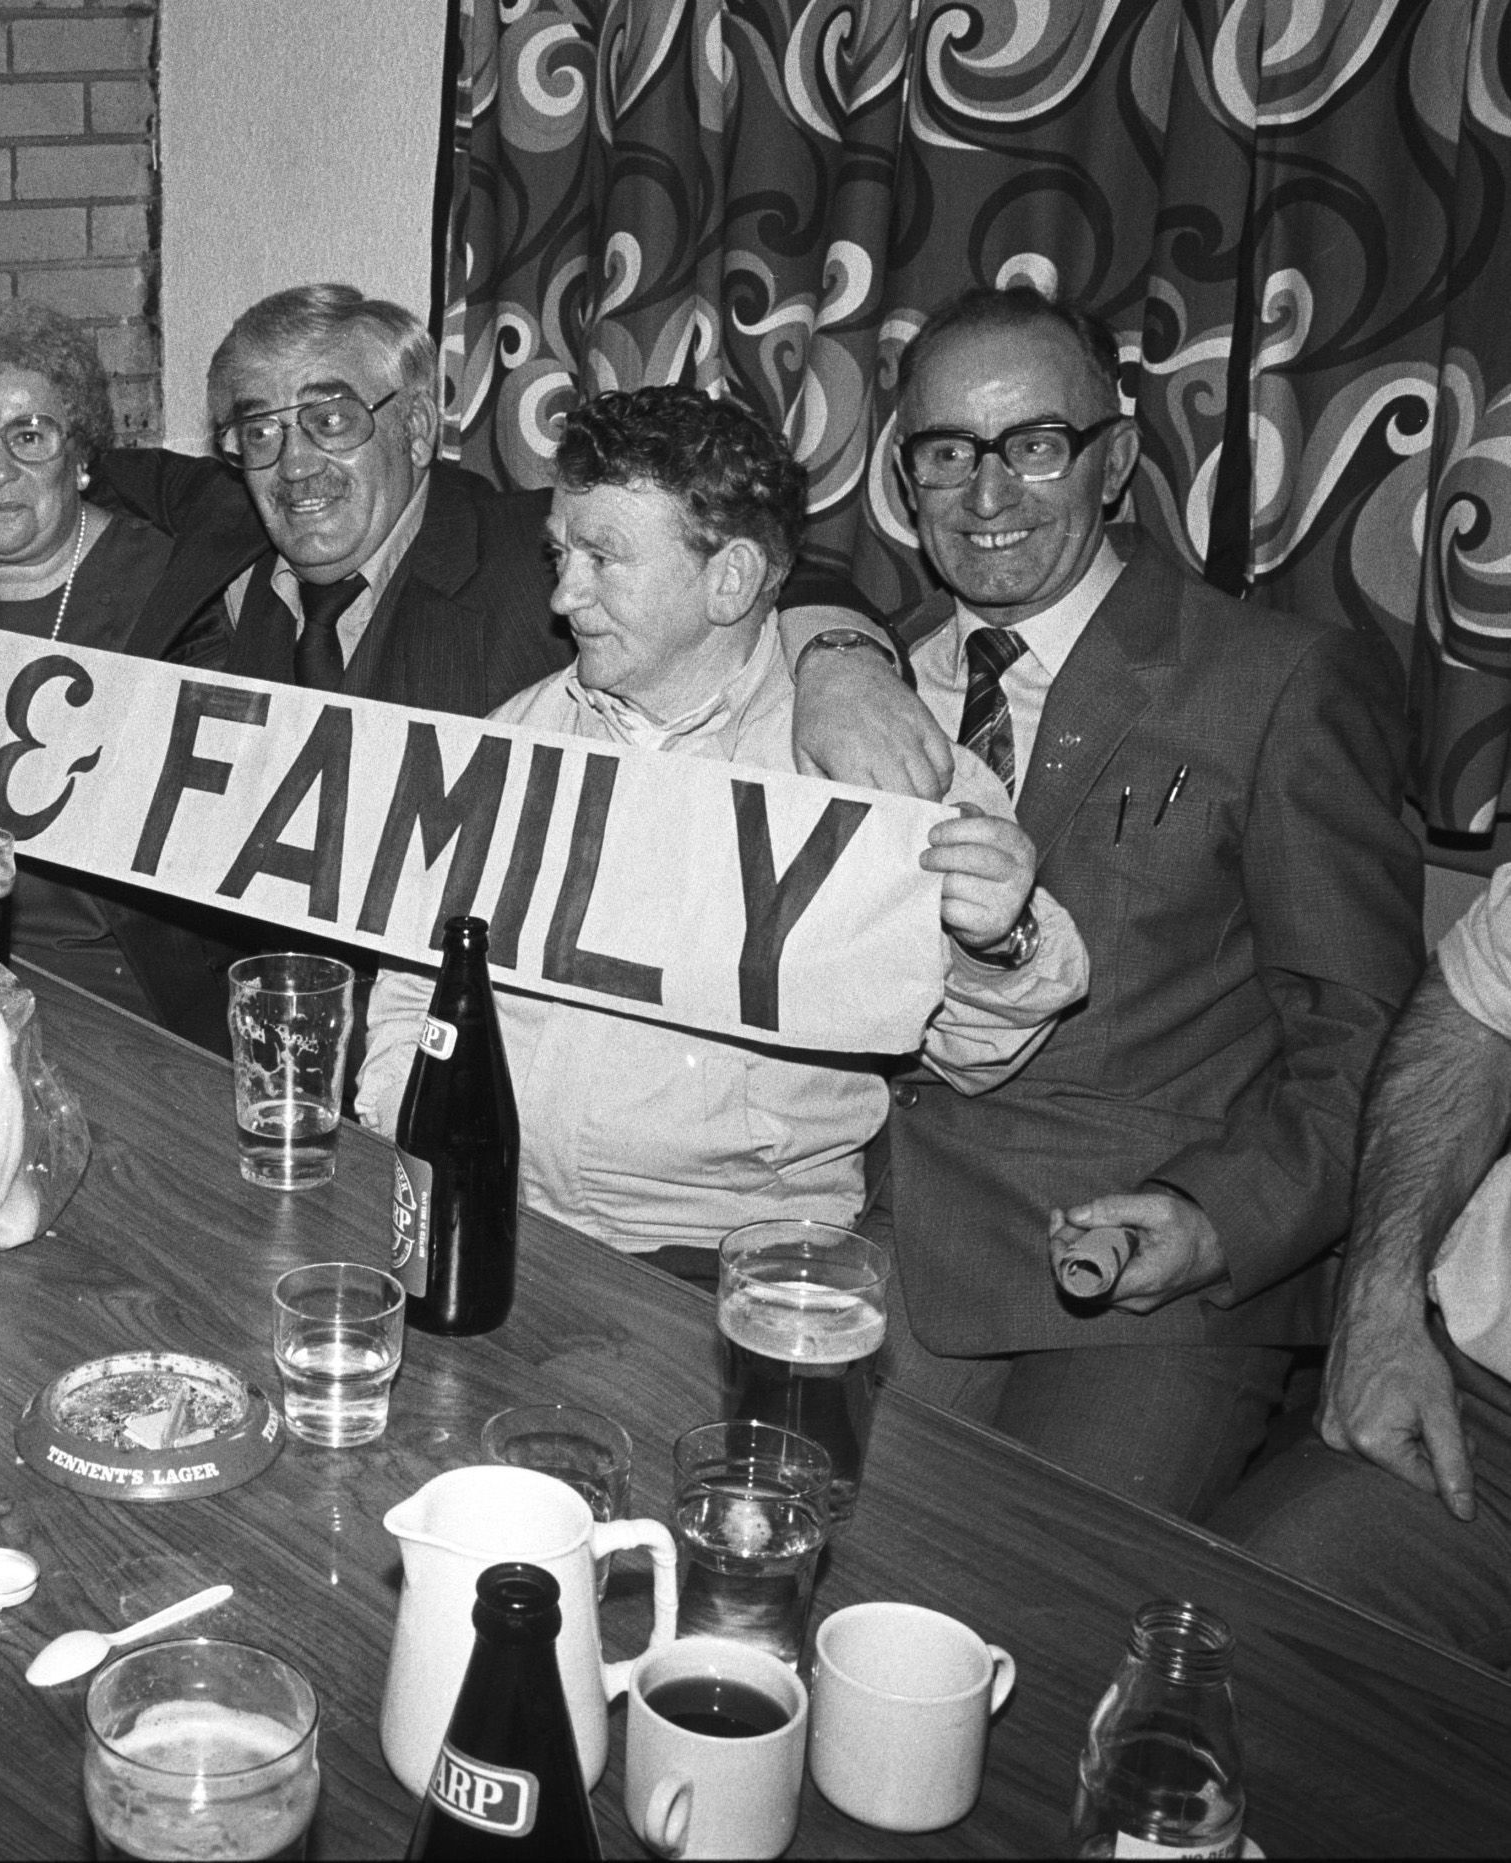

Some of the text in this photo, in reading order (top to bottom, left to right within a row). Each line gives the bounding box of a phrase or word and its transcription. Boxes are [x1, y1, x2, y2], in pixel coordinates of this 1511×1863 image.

[130, 679, 873, 1032] FAMILY
[46, 1445, 220, 1485] TENNENT'S LAGER
